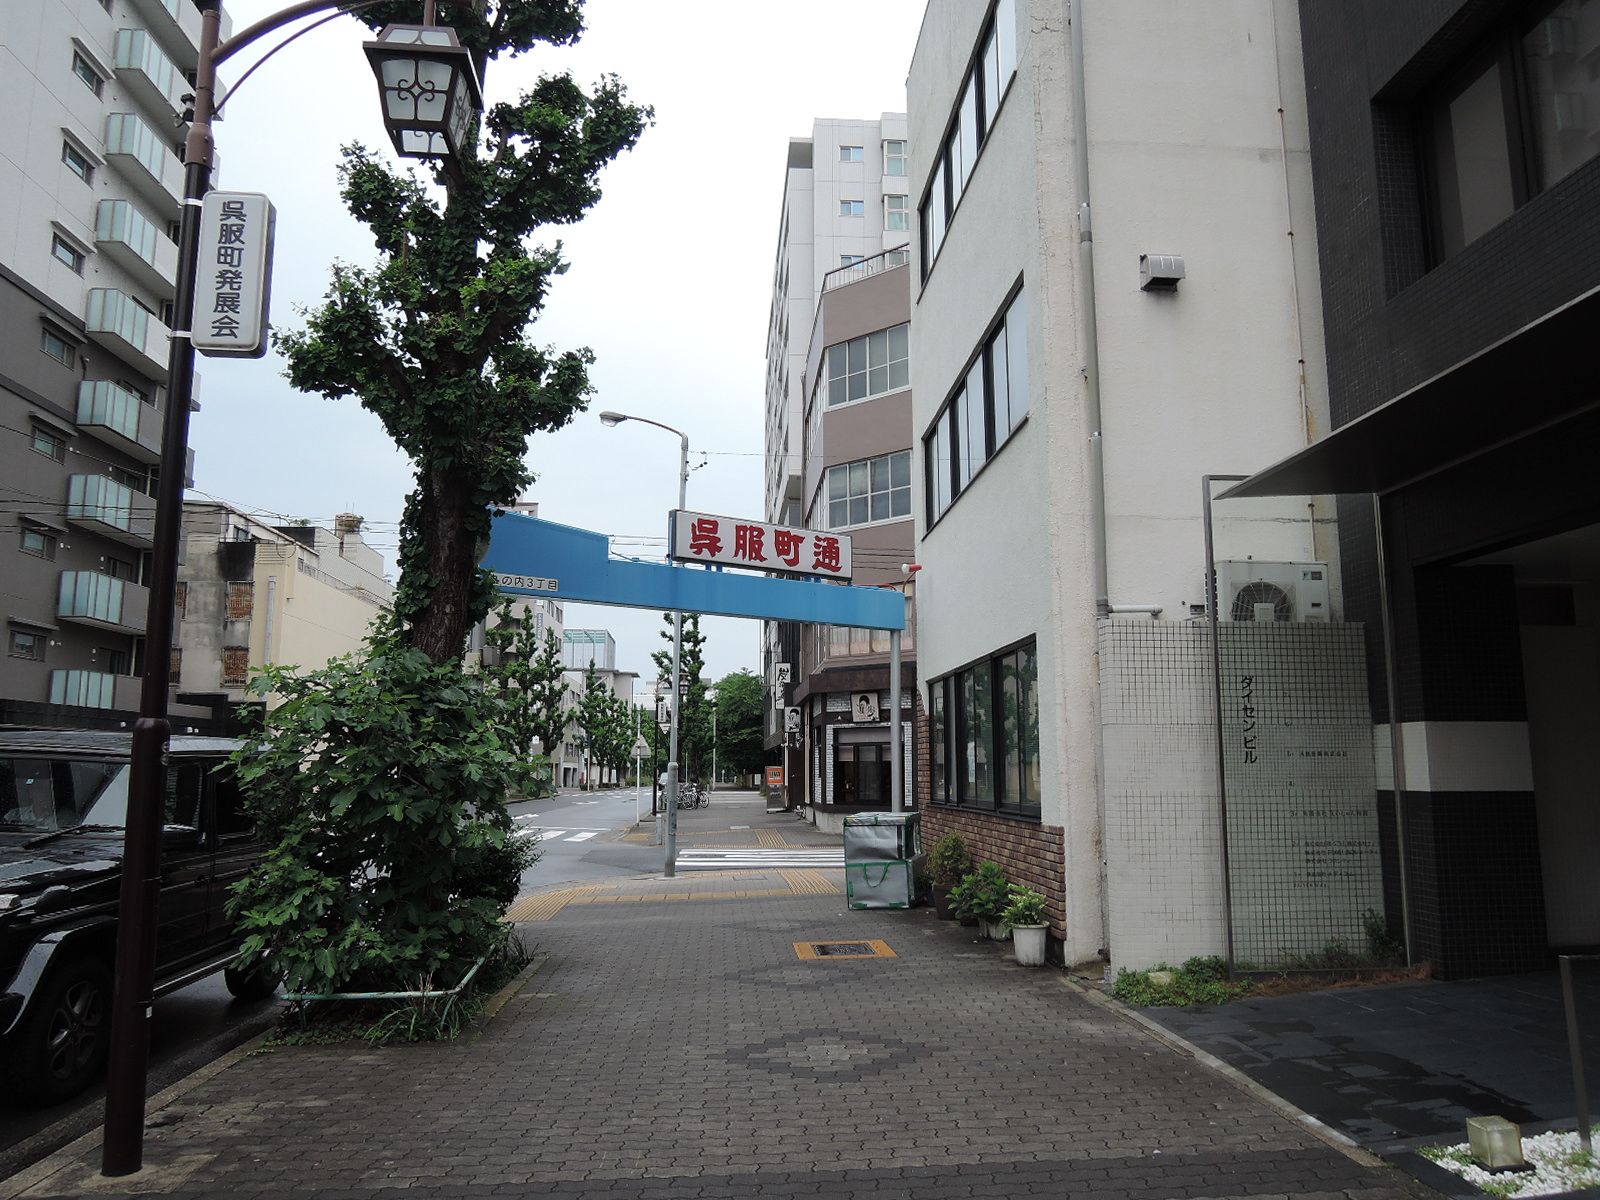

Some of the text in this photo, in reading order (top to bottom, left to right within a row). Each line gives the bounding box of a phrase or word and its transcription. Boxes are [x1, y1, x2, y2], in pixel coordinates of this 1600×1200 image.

[210, 200, 247, 339] 呉服町発展会
[689, 518, 842, 572] 呉服町通
[1240, 675, 1258, 764] ダイセンビル
